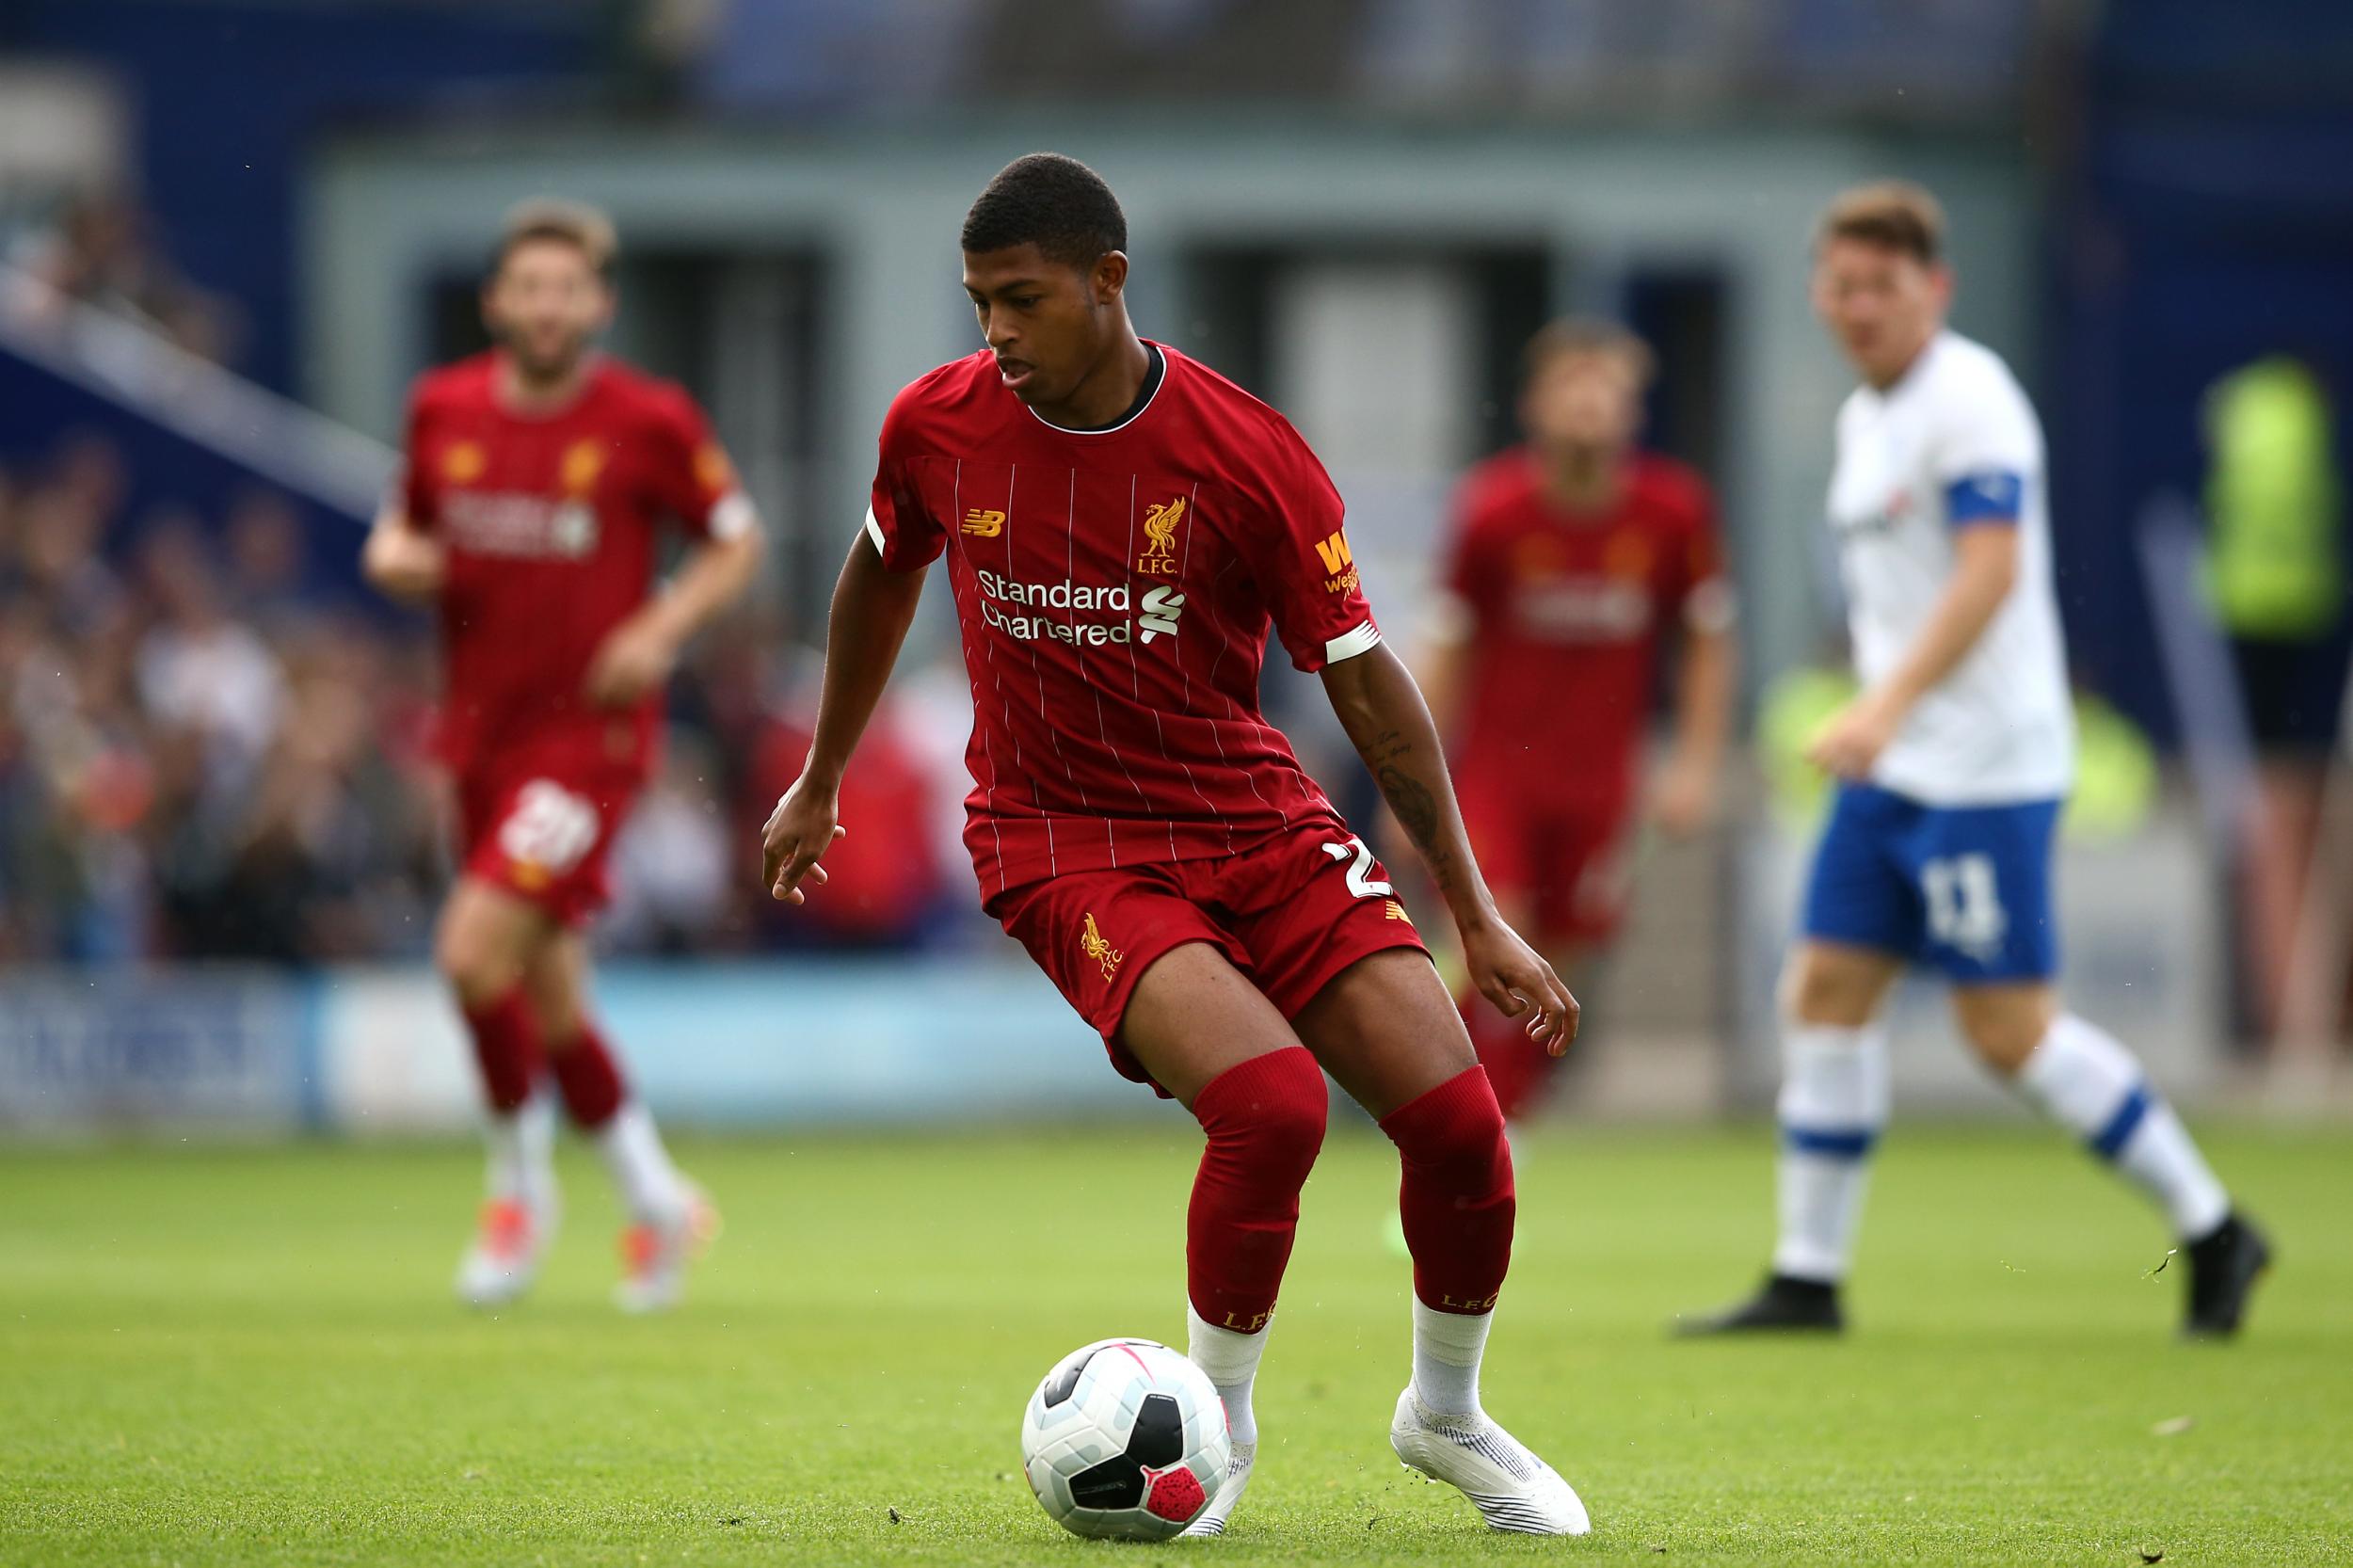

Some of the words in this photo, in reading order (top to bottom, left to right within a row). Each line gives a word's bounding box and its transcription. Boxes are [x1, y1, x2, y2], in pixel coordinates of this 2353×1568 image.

[1137, 558, 1178, 575] L.F.C.
[978, 569, 1130, 612] Standard
[981, 597, 1130, 647] Chartered
[1321, 838, 1394, 899] 2
